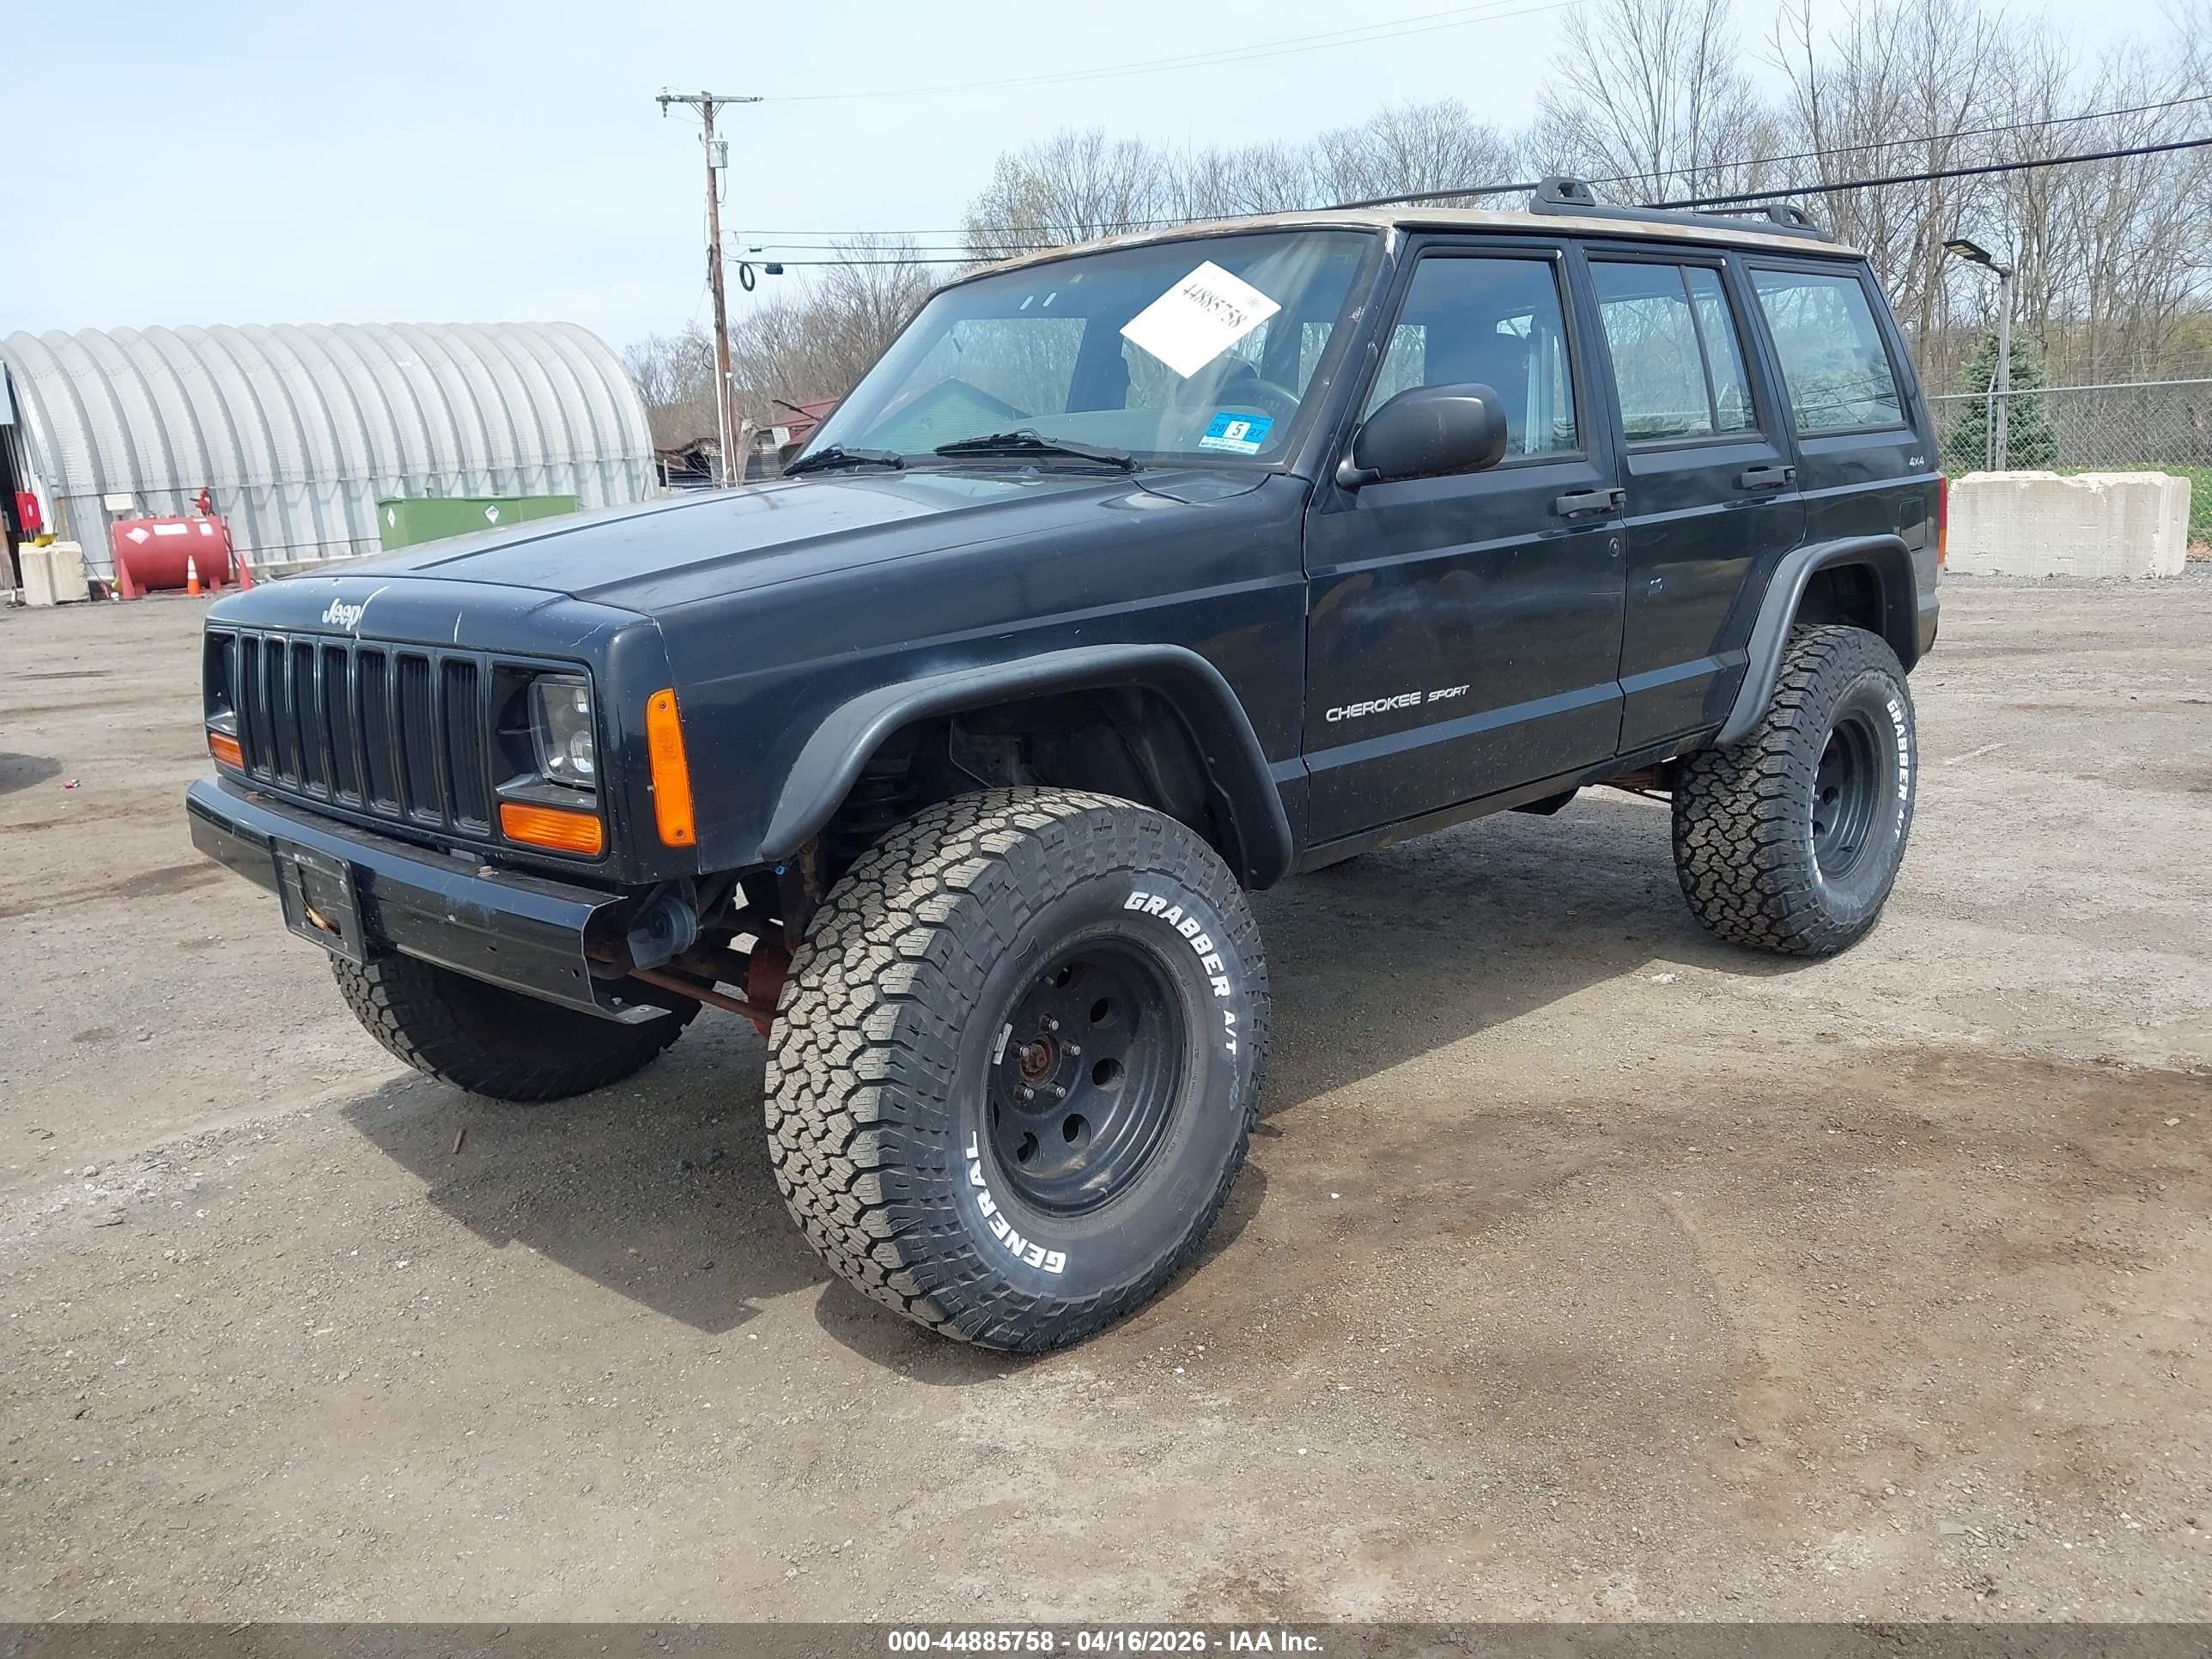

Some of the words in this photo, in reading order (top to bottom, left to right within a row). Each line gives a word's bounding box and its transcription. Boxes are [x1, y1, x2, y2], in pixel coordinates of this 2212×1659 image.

[1182, 283, 1248, 328] 44885758
[1211, 422, 1226, 432] 20
[1232, 423, 1244, 436] 5
[1249, 428, 1264, 437] 27
[322, 598, 361, 631] Jeep
[1325, 691, 1422, 722] CHEROKEE
[1428, 684, 1470, 702] SPORT
[1887, 699, 1909, 801] GRABBER
[1892, 809, 1905, 843] A/T
[1123, 890, 1231, 999] GRABBER
[1223, 1009, 1237, 1055] A/T
[965, 1131, 1066, 1274] GENERAL
